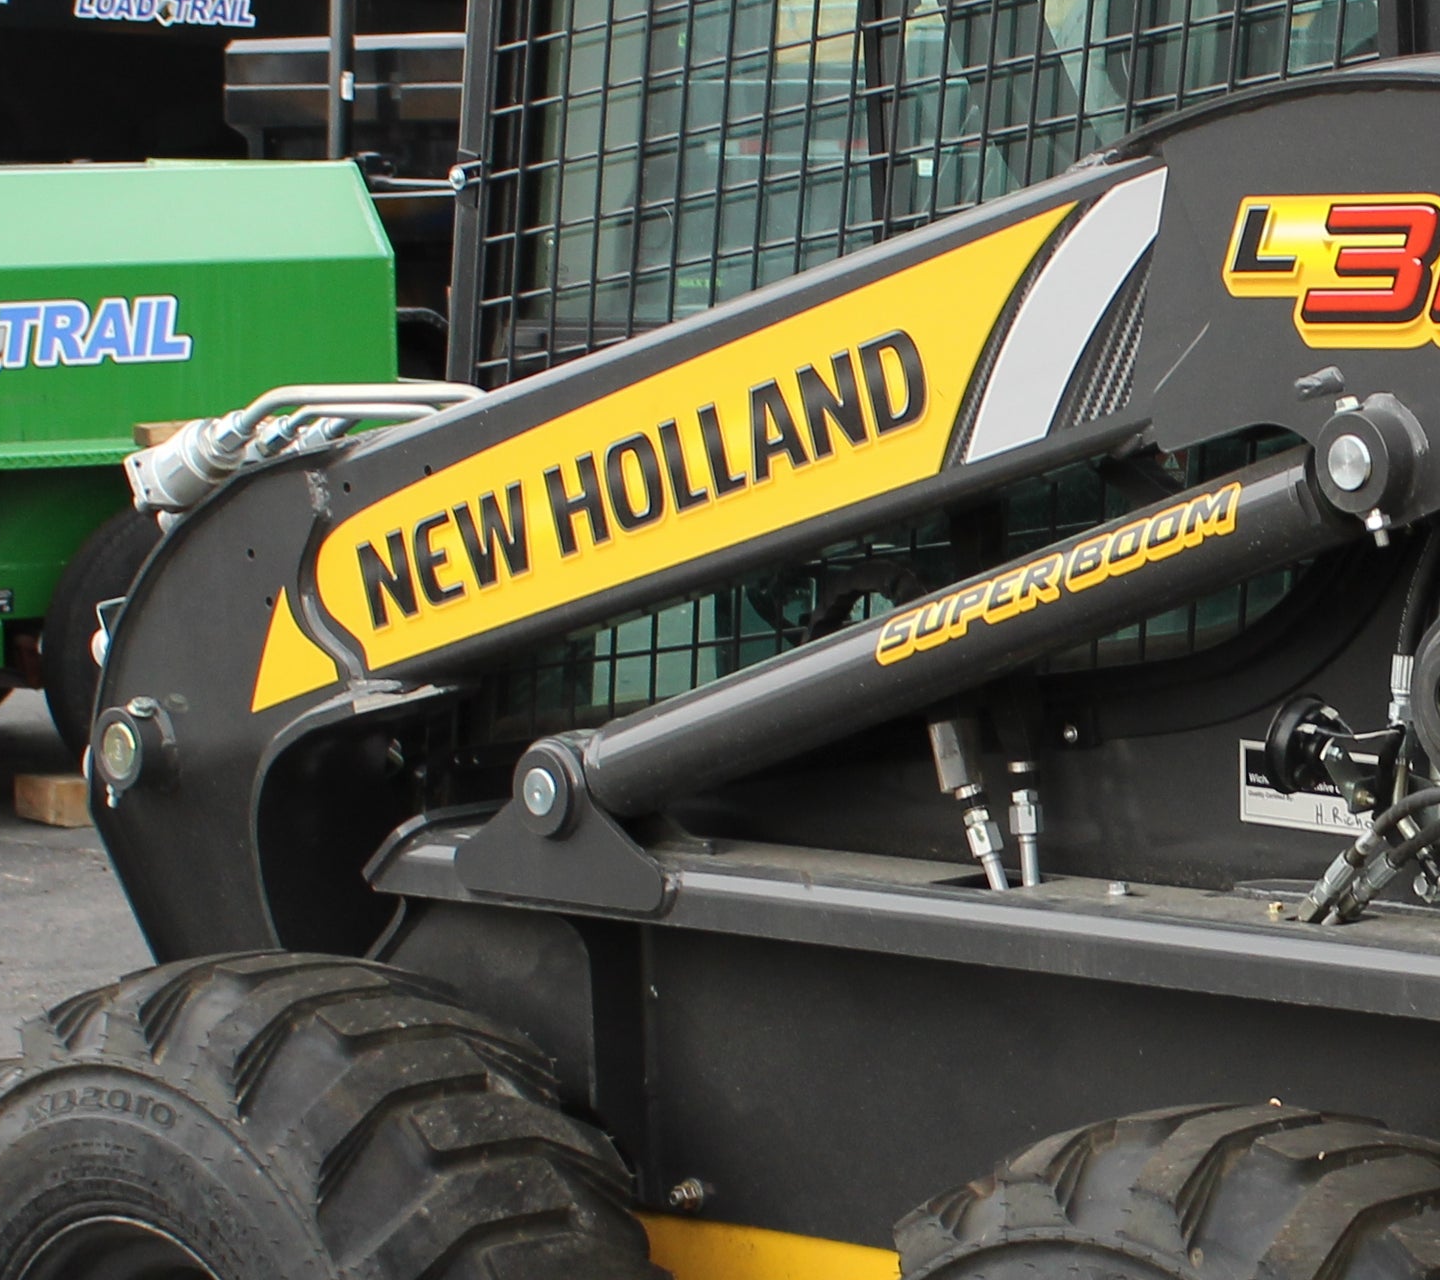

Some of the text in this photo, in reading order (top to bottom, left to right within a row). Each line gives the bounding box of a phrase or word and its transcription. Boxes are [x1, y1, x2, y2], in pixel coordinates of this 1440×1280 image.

[356, 329, 927, 630] NEW HOLLAND
[876, 481, 1242, 666] SUPER BOOM
